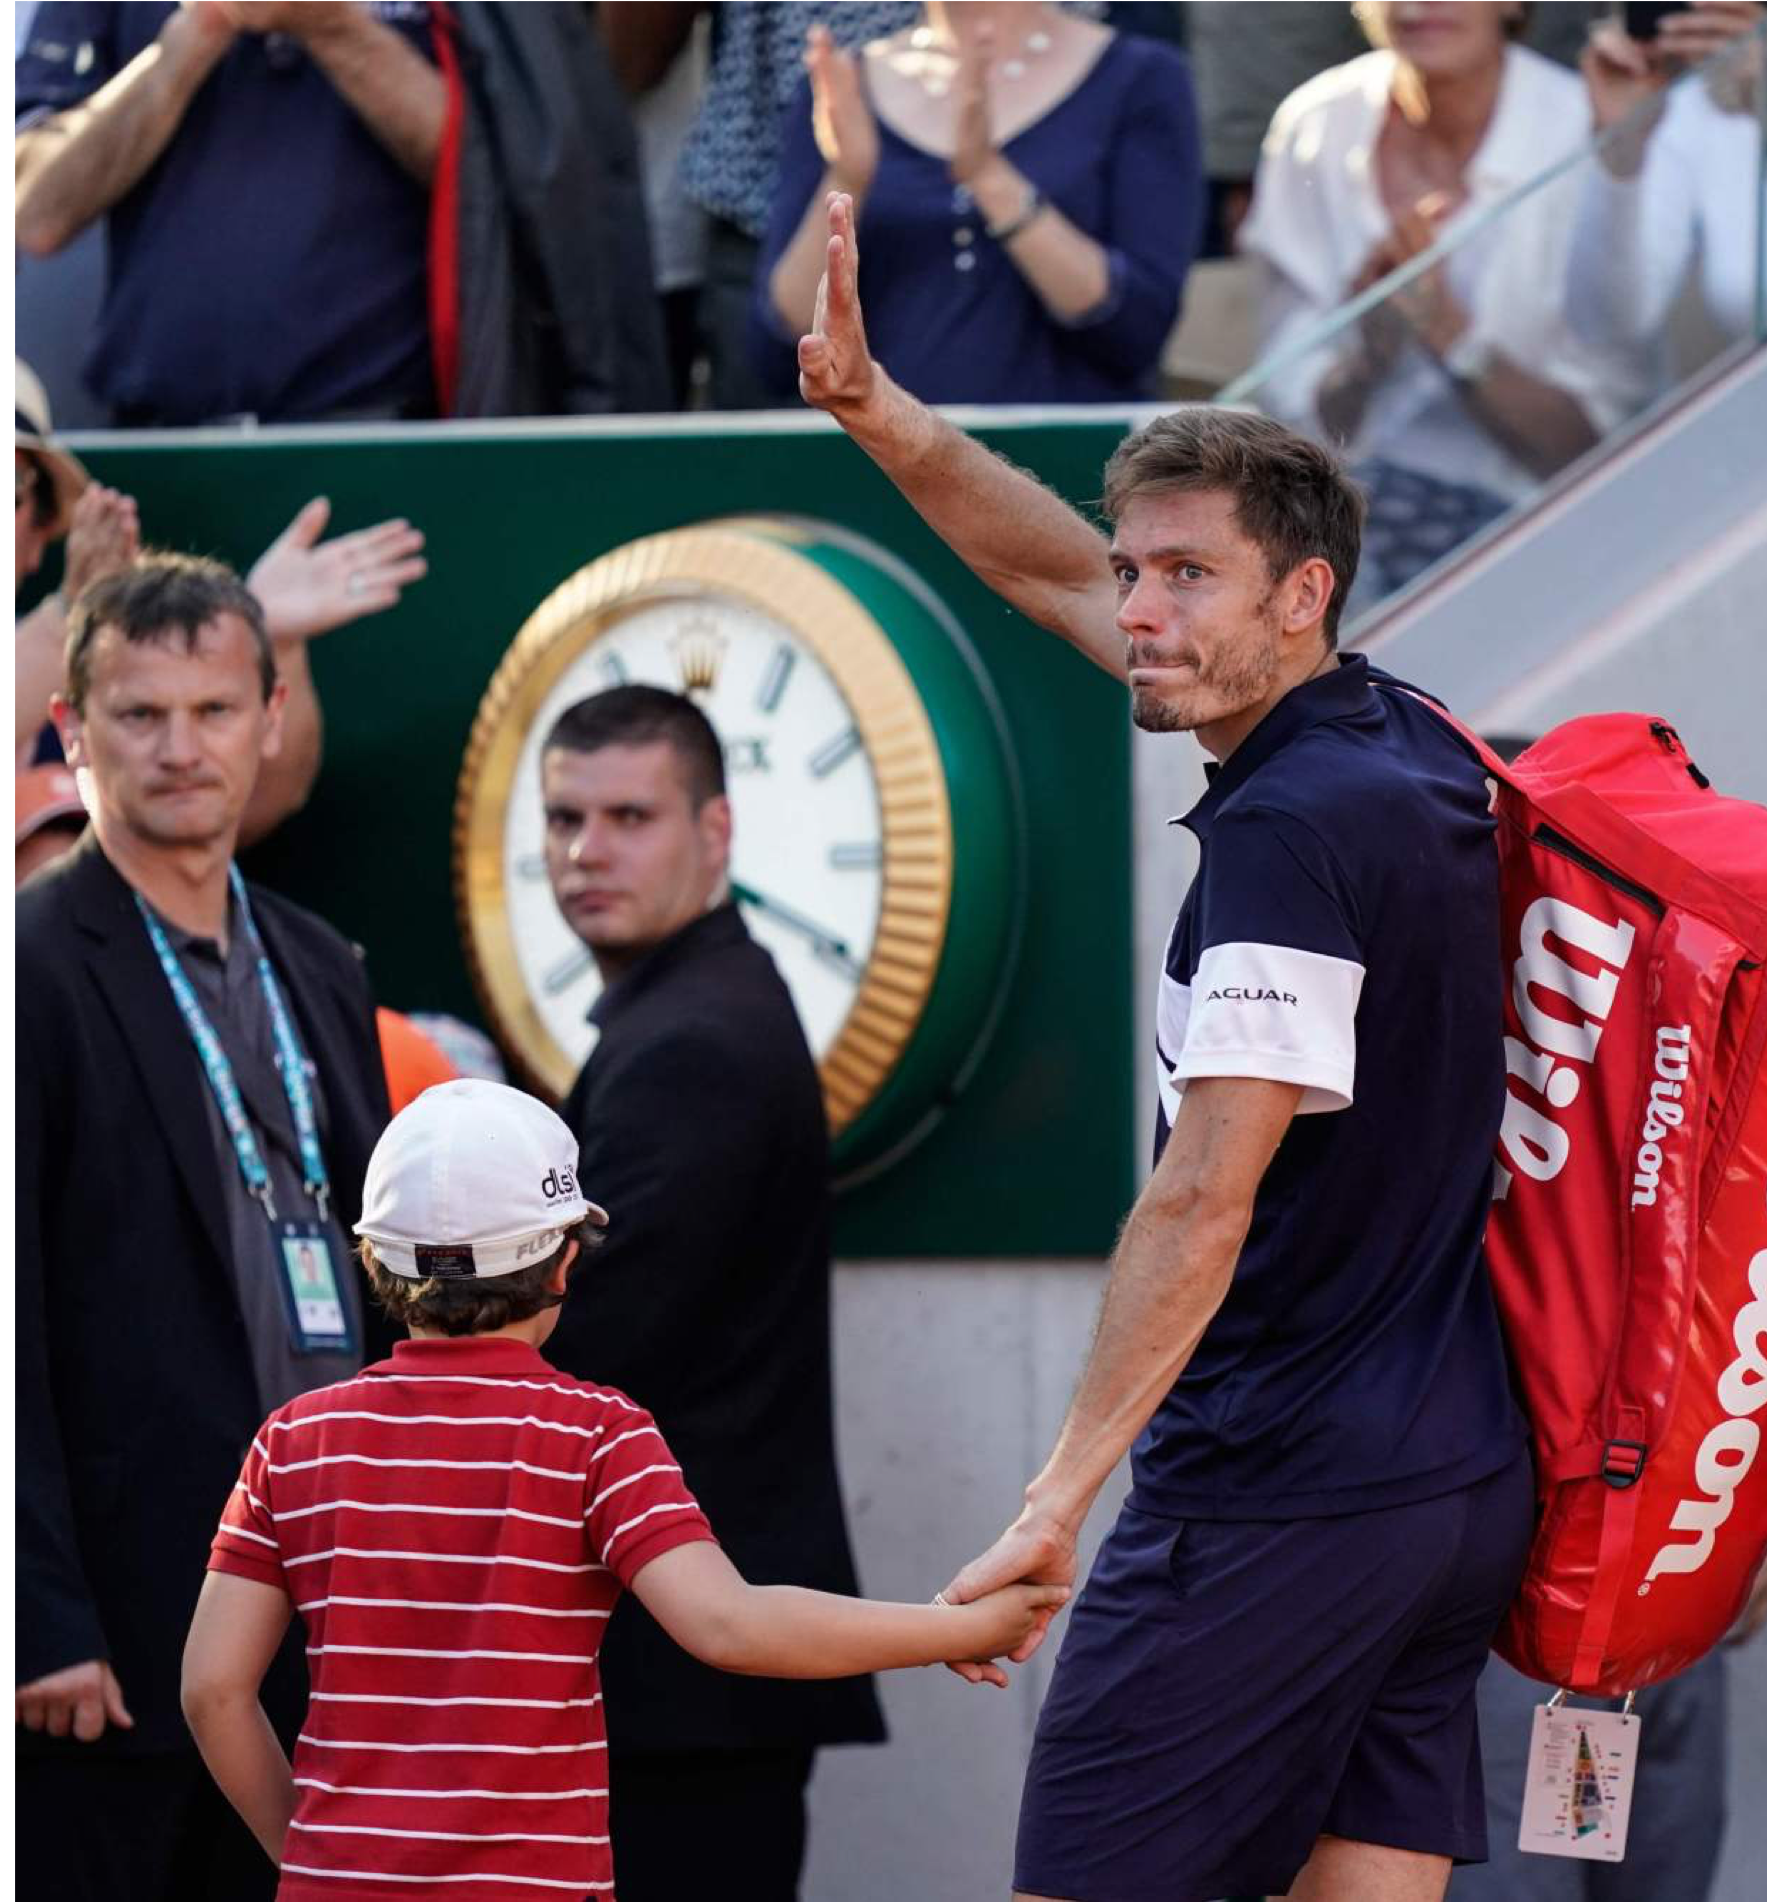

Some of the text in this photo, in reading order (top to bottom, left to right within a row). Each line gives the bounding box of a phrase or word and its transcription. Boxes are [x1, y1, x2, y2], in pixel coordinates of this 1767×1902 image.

[1206, 987, 1298, 1006] AGUAR
[1493, 896, 1635, 1200] Wil
[1632, 1024, 1692, 1206] Wilson
[1644, 1248, 1767, 1580] son
